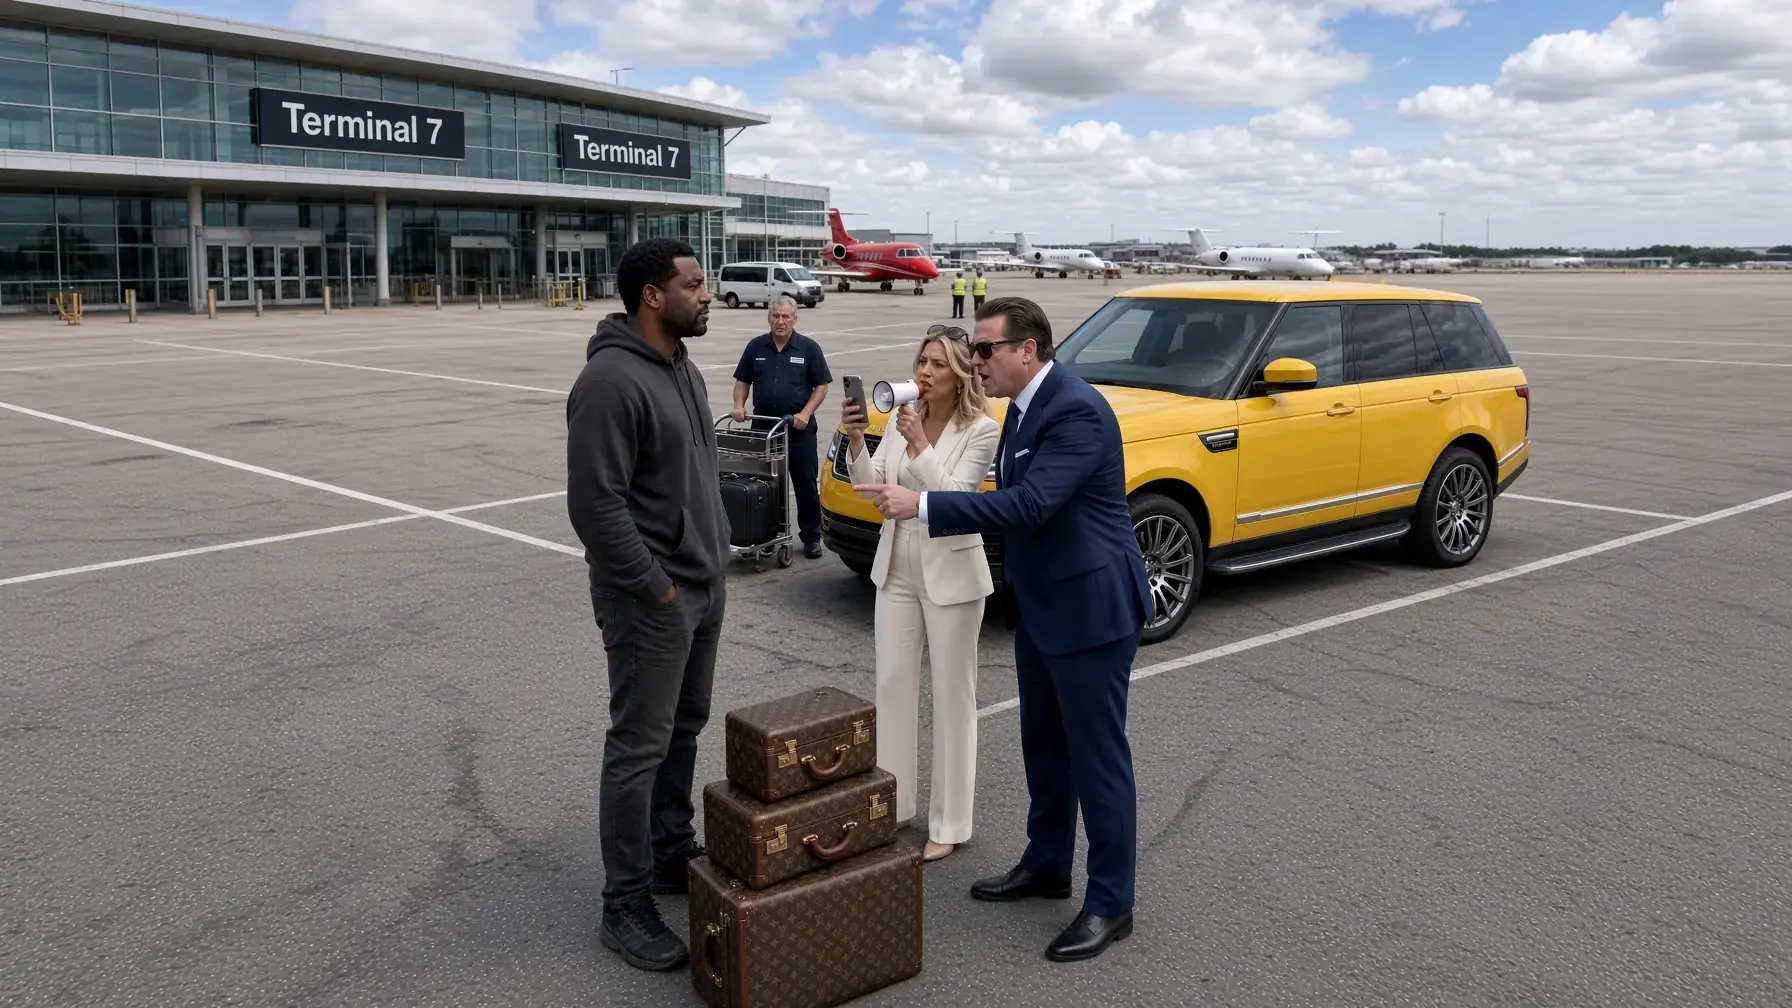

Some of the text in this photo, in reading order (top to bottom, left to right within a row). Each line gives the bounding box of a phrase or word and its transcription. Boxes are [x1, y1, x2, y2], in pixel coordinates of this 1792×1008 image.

[281, 101, 443, 145] Terminal 7
[573, 133, 680, 168] Terminal 7
